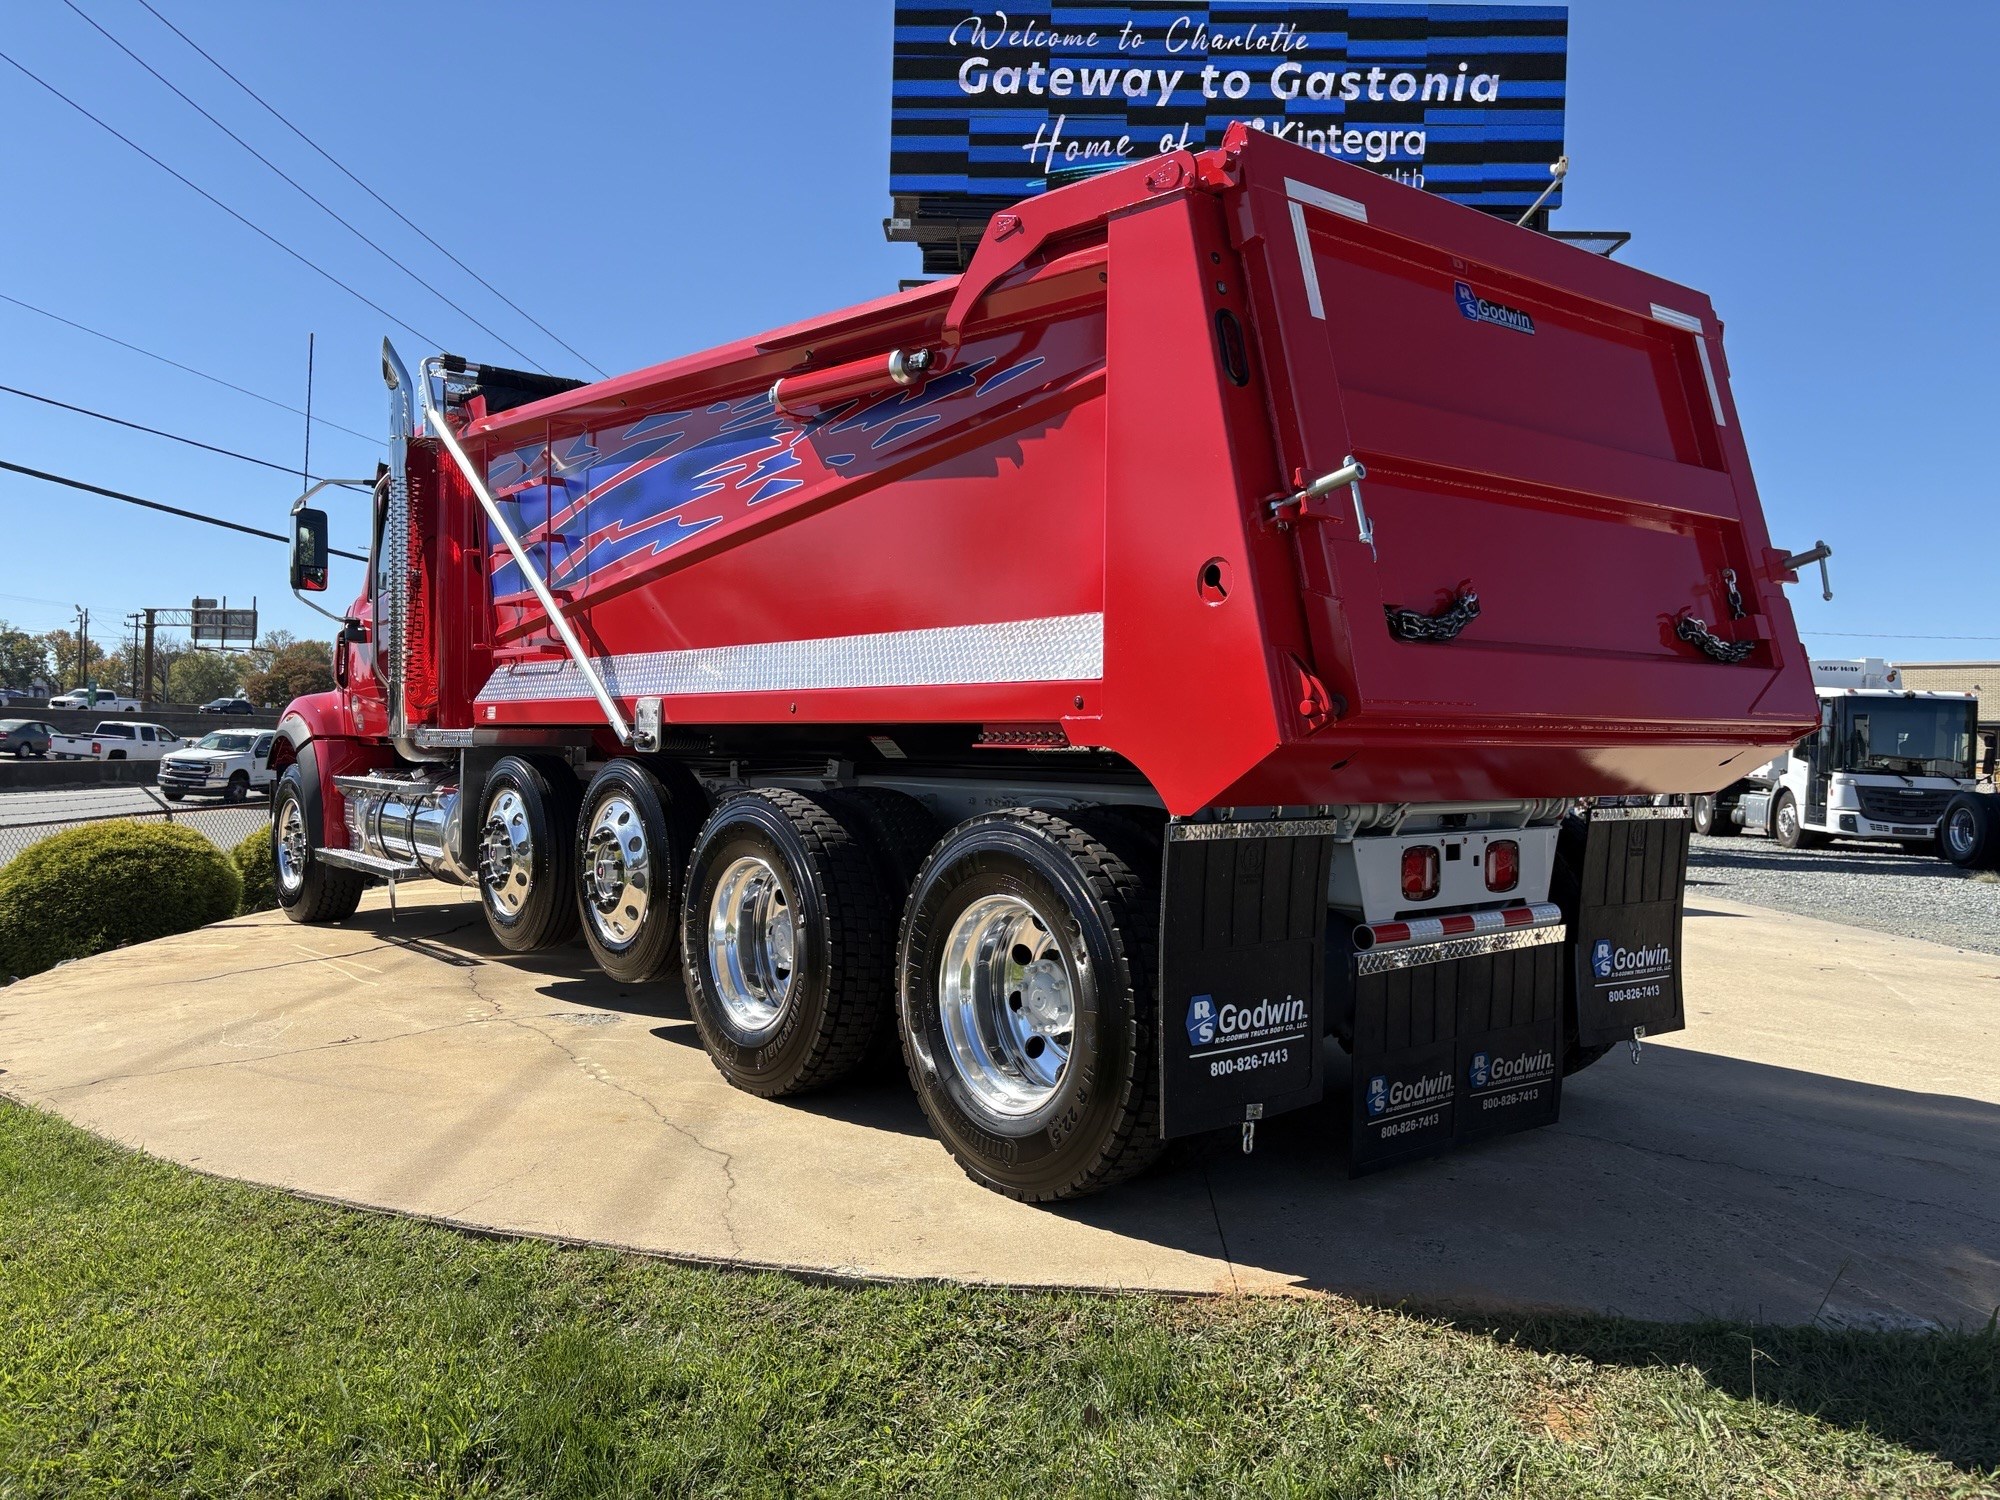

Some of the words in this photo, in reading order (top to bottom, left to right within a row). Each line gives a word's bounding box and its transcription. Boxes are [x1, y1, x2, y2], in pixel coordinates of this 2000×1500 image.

[950, 10, 1099, 50] Welcome
[1118, 20, 1145, 50] to
[1166, 16, 1309, 52] Charlotte
[958, 56, 1184, 107] Gateway
[1201, 64, 1250, 100] to
[1270, 62, 1500, 102] Gastonia
[1022, 114, 1134, 174] Home
[1478, 299, 1530, 328] Godwin
[1614, 944, 1668, 970] Godwin
[1609, 985, 1660, 1002] 800-826-7413
[1219, 995, 1304, 1033] Godwin
[1250, 1028, 1268, 1036] TRUCK
[1270, 1026, 1284, 1034] BODY
[1210, 1048, 1288, 1076] 800-826-7413
[1491, 1049, 1552, 1079] Godwin
[1390, 1071, 1452, 1104] Godwin
[1482, 1088, 1538, 1110] 800-826-7413
[1050, 1104, 1079, 1146] 22.5
[1381, 1113, 1439, 1139] 800-826-7413
